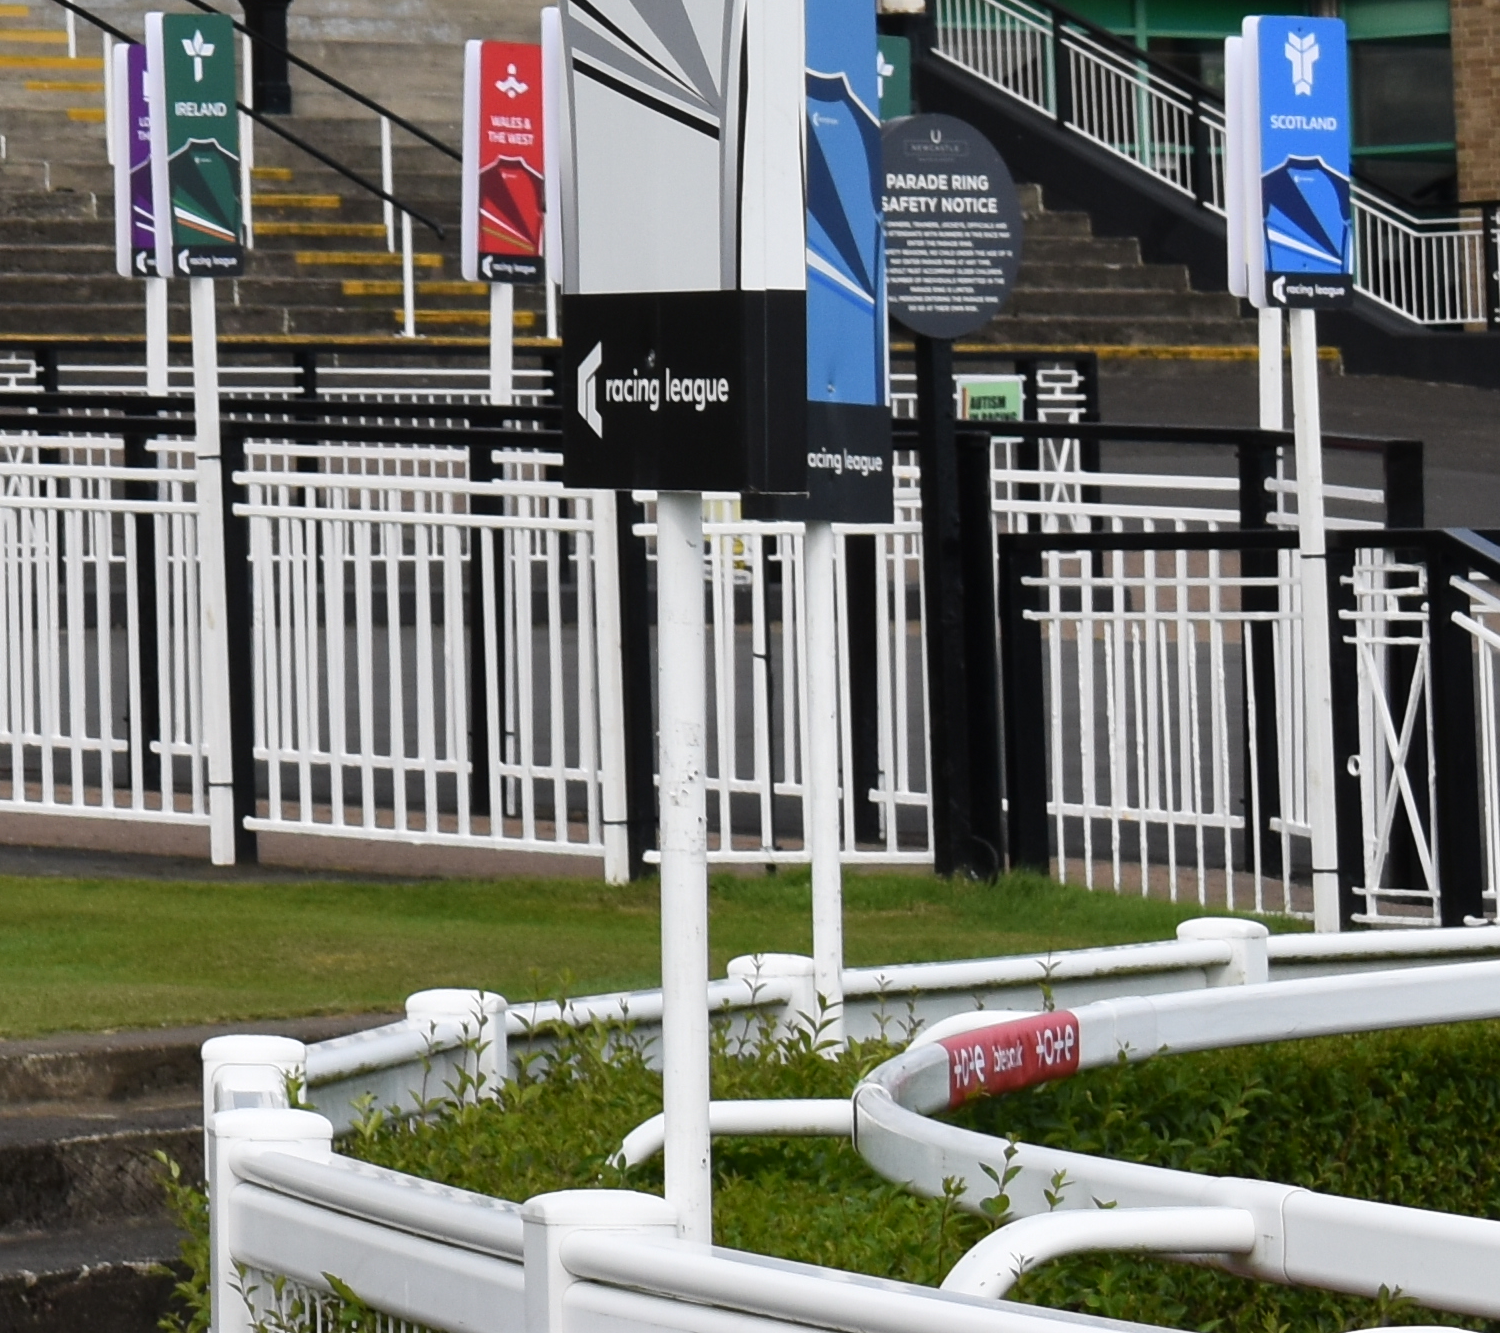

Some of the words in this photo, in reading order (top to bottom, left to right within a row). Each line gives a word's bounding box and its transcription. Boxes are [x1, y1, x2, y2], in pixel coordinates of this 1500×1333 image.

[174, 101, 228, 118] IRELAND
[1270, 114, 1338, 132] SCOTLAND
[886, 173, 949, 191] PARADE
[951, 175, 990, 191] RING
[882, 195, 939, 213] SAFETY
[941, 197, 999, 214] NOTICE
[605, 368, 660, 412] racing
[665, 367, 730, 412] league
[807, 446, 842, 476] acing
[844, 447, 884, 477] league
